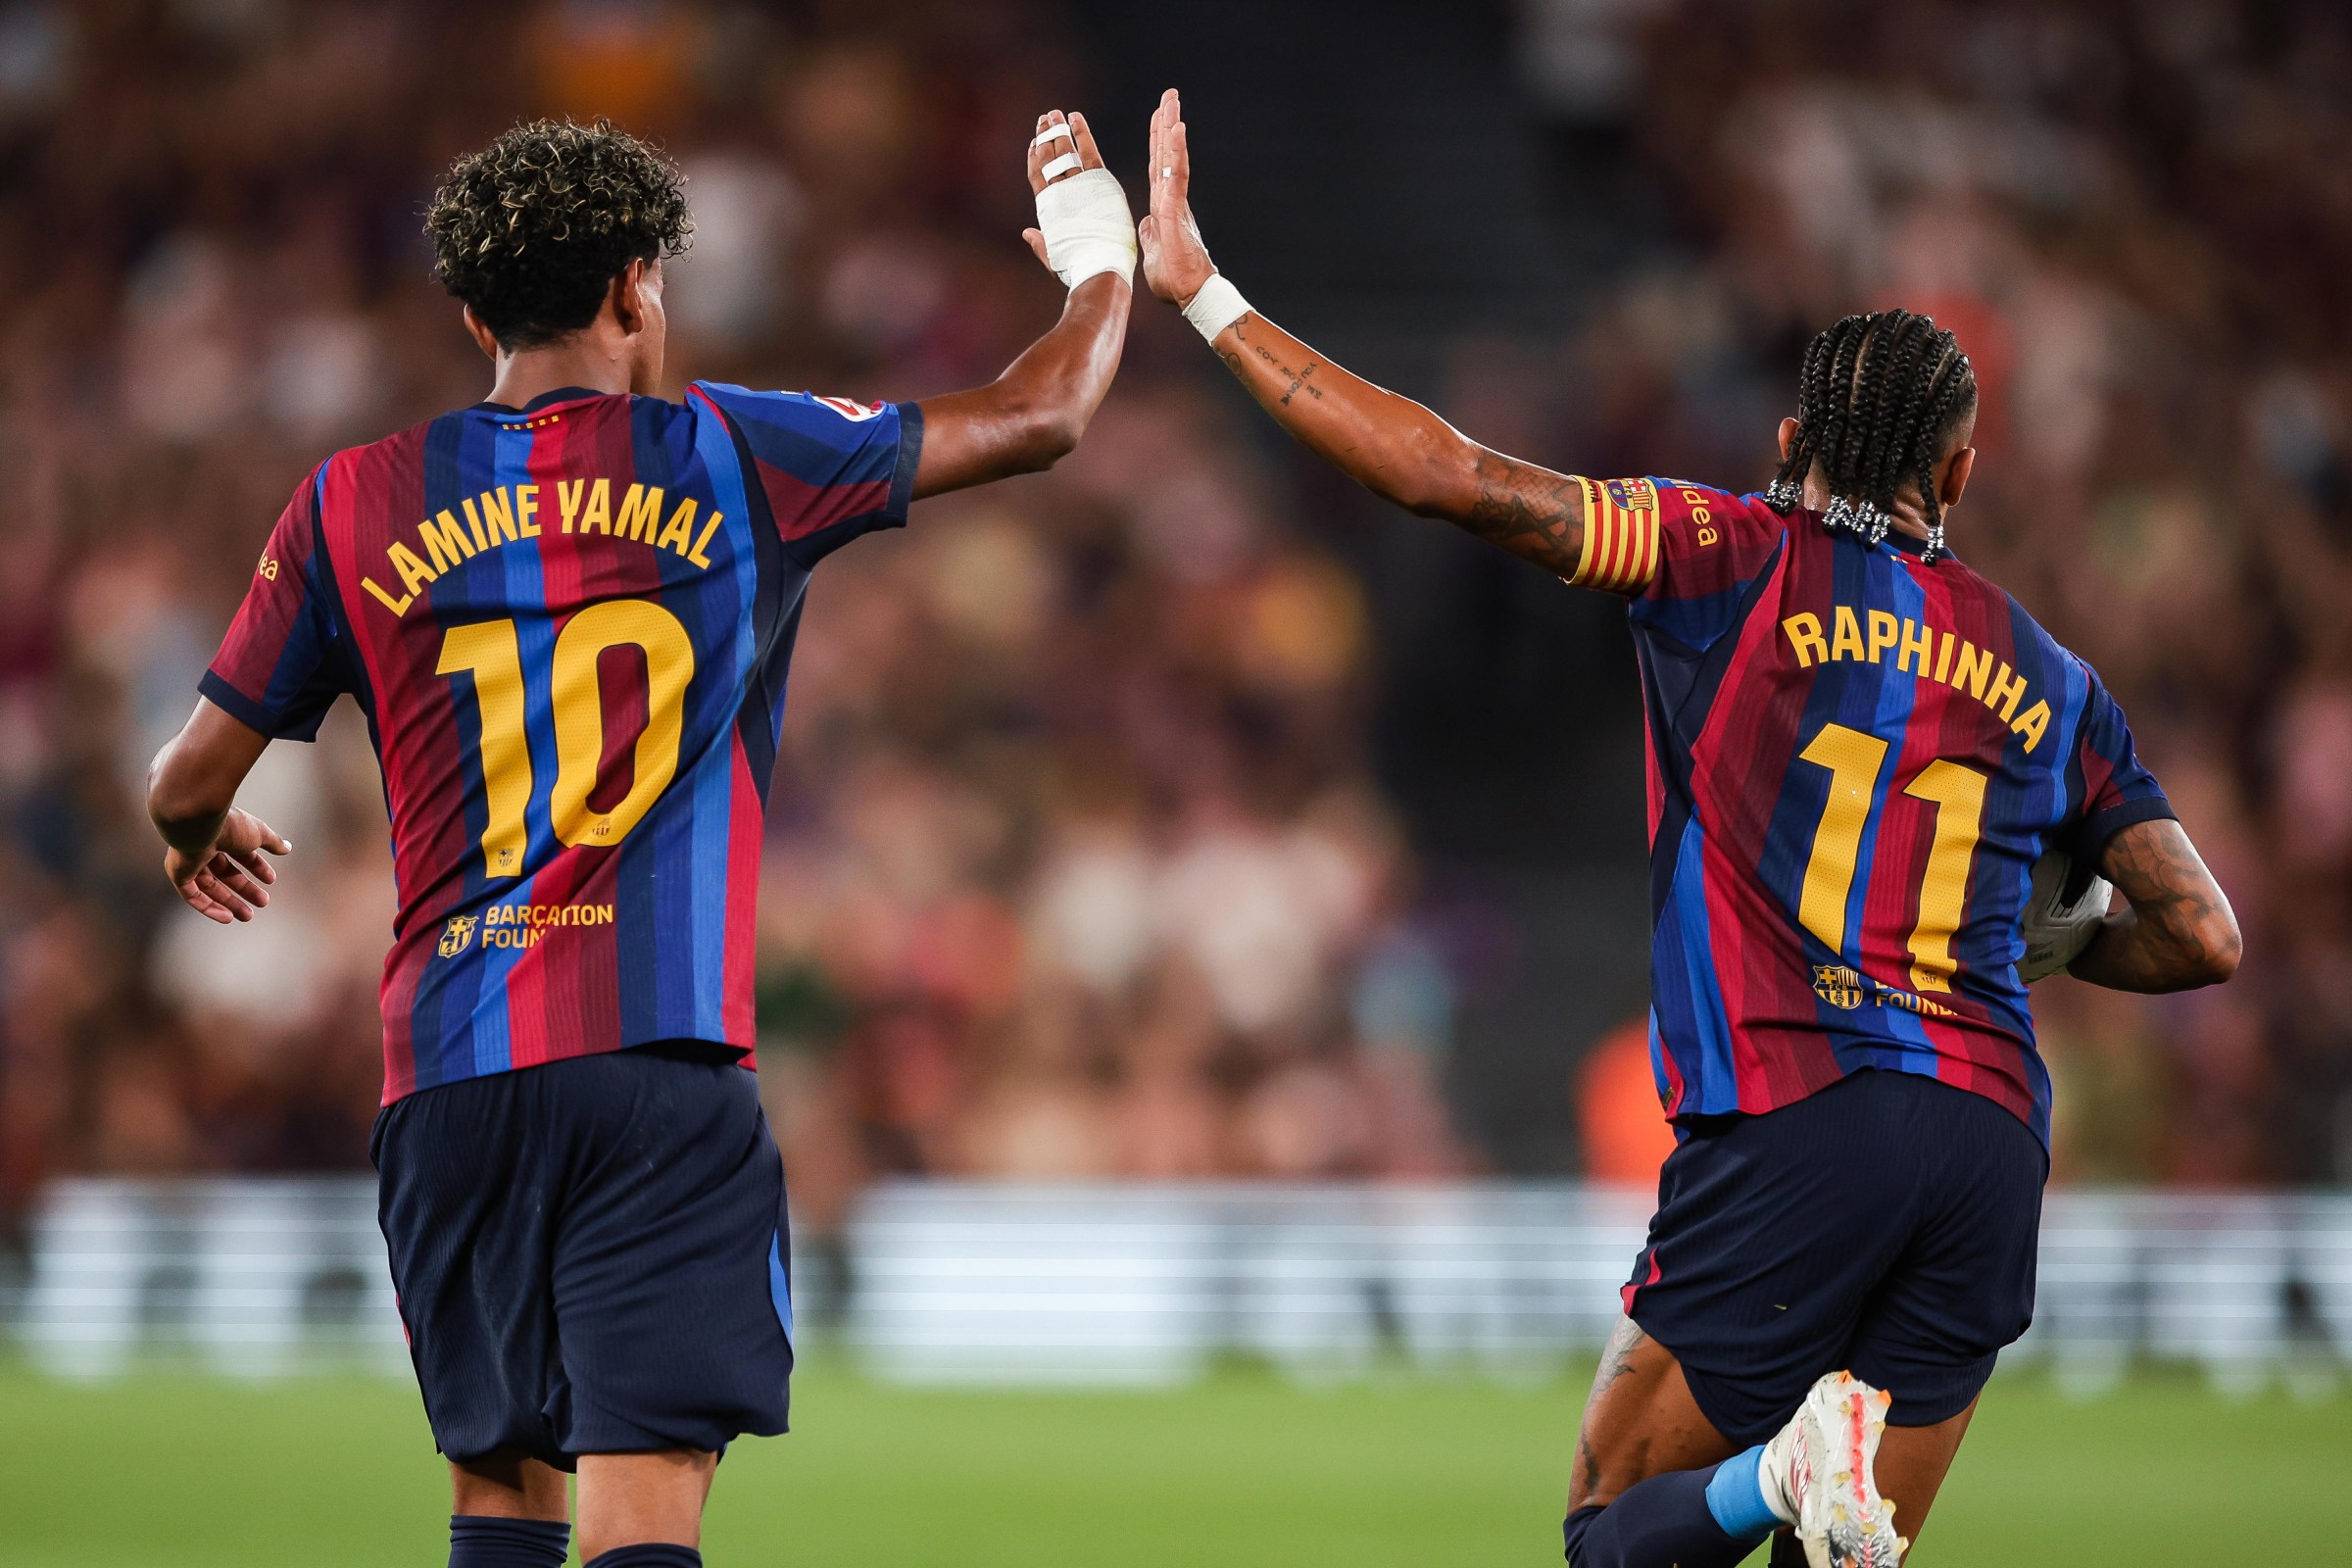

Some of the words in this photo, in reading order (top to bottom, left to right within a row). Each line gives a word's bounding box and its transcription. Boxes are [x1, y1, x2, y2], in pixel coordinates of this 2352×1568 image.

[361, 485, 542, 617] LAMINE
[558, 478, 723, 570] YAMAL
[1671, 480, 1718, 547] idea
[435, 599, 695, 879] 10
[1782, 606, 2051, 754] RAPHINHA
[1798, 722, 1988, 994] 11
